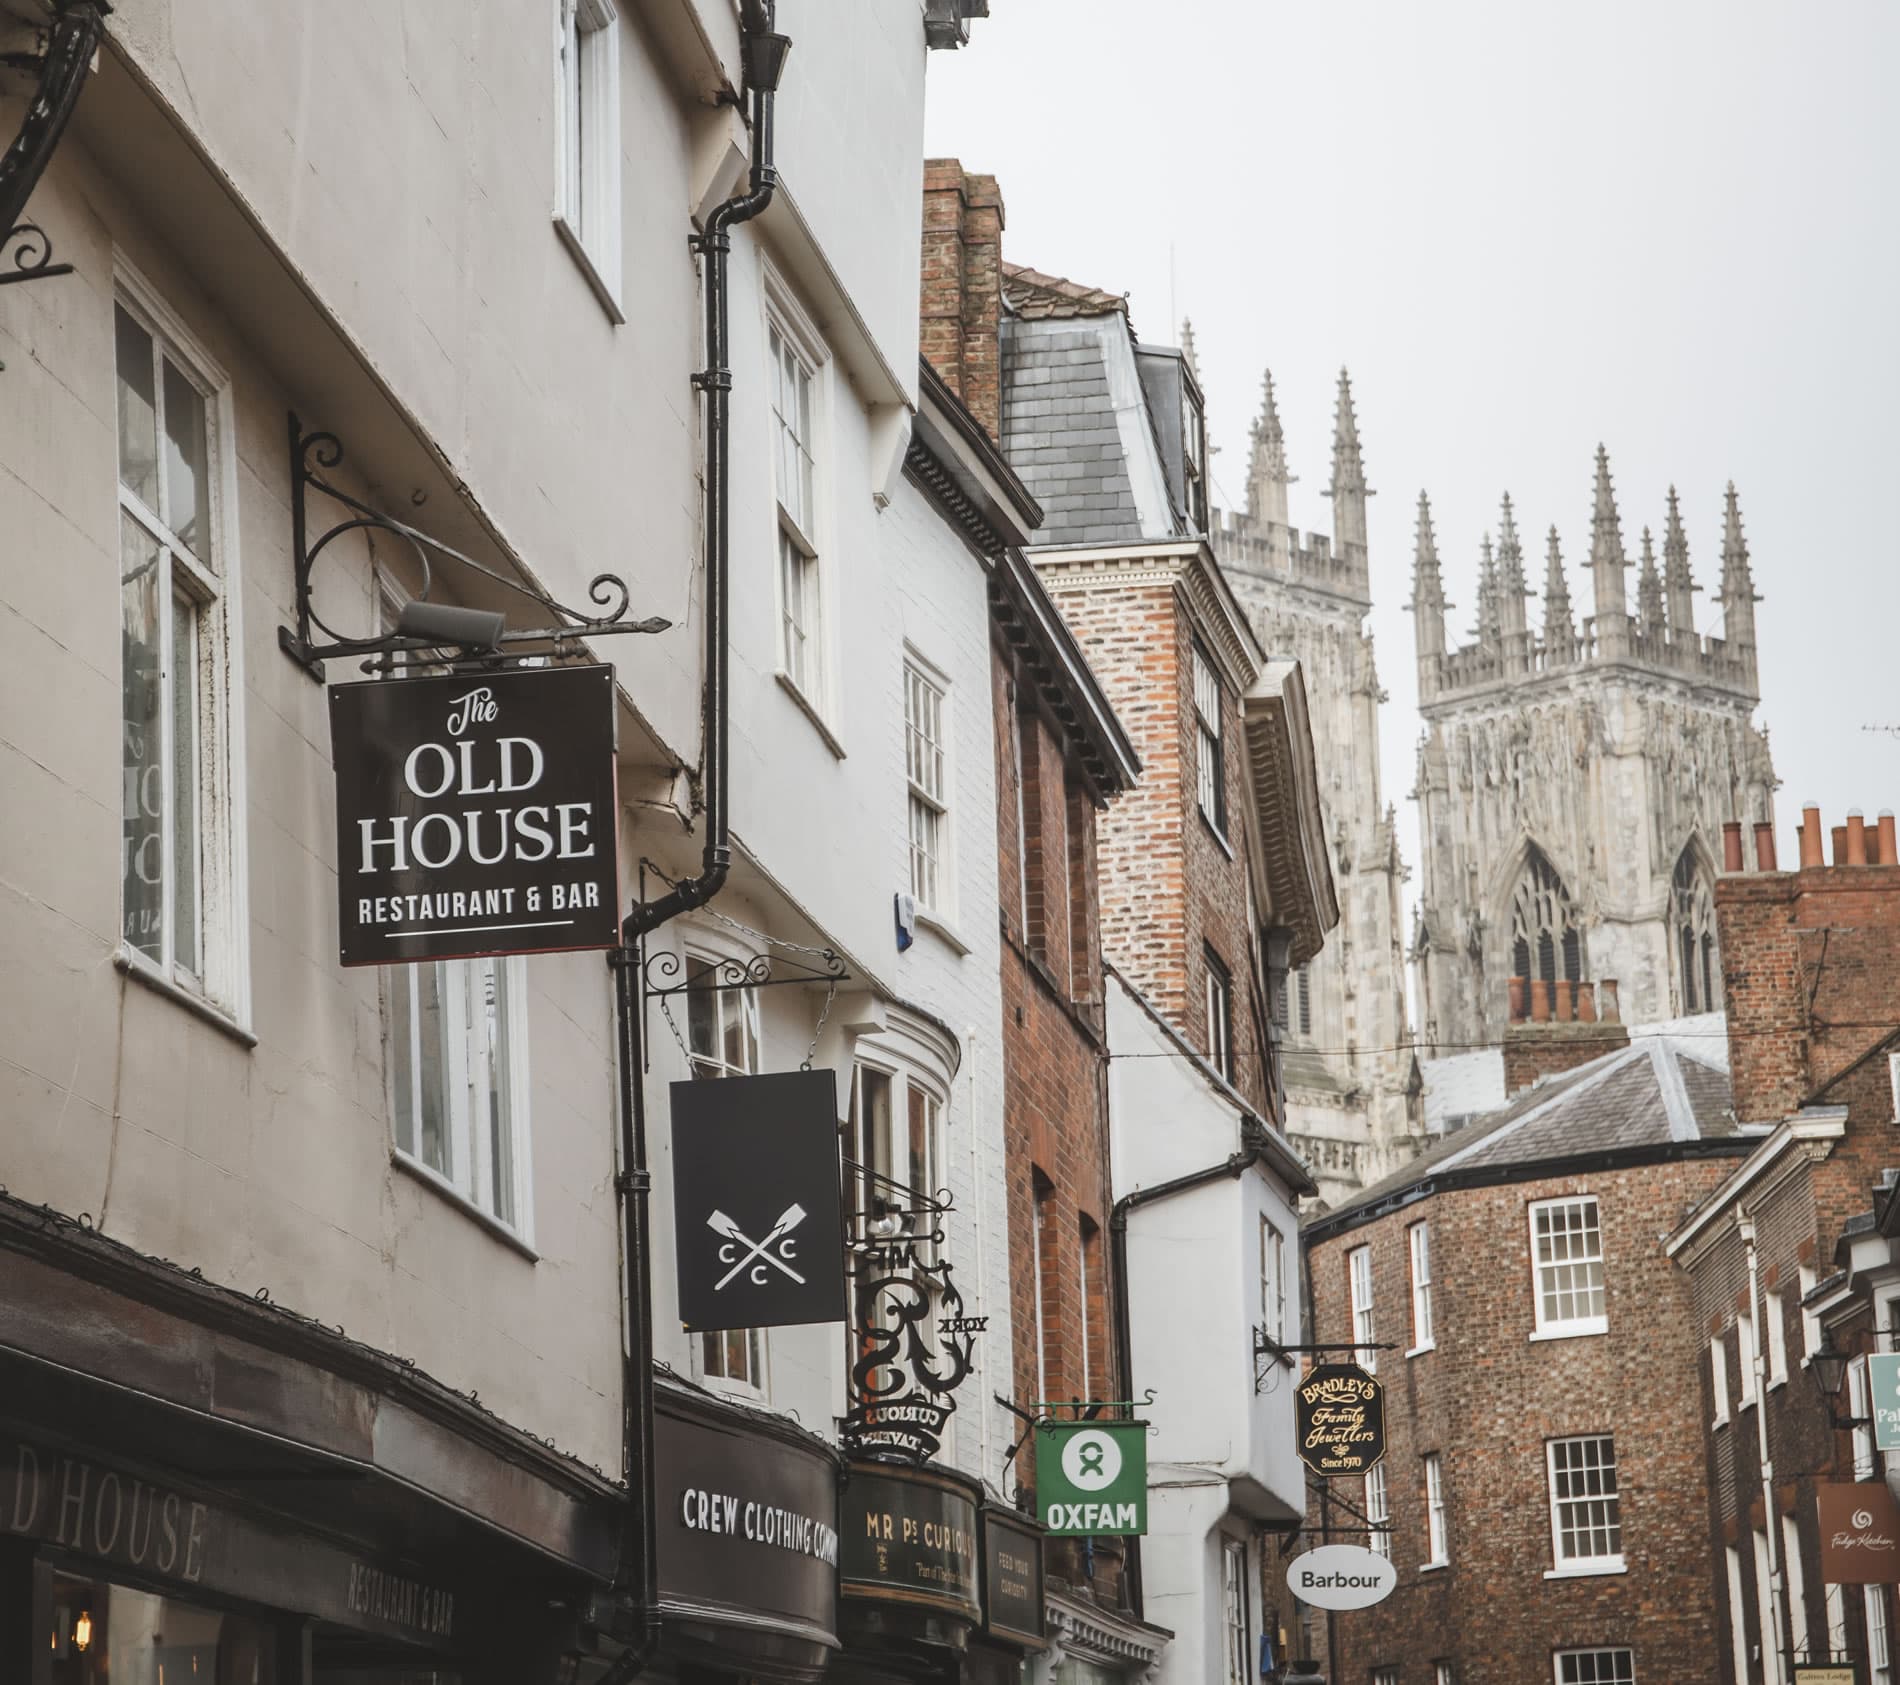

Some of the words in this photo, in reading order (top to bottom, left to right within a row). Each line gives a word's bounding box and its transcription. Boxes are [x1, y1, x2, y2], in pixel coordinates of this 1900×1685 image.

[447, 687, 498, 735] The
[404, 737, 544, 798] OLD
[357, 803, 594, 873] HOUSE
[358, 887, 515, 924] RESTAURANT
[526, 886, 541, 911] &
[551, 881, 600, 910] BAR
[1311, 1406, 1366, 1430] Family
[1305, 1425, 1374, 1449] Jewellers
[1321, 1457, 1342, 1469] Since
[1343, 1456, 1362, 1471] 1970
[56, 1458, 208, 1582] HOUSE
[683, 1488, 738, 1536] CREW
[745, 1501, 811, 1555] CLOTHING
[867, 1511, 894, 1540] MR
[1047, 1503, 1137, 1530] OXFAM
[1301, 1571, 1382, 1588] Barbour
